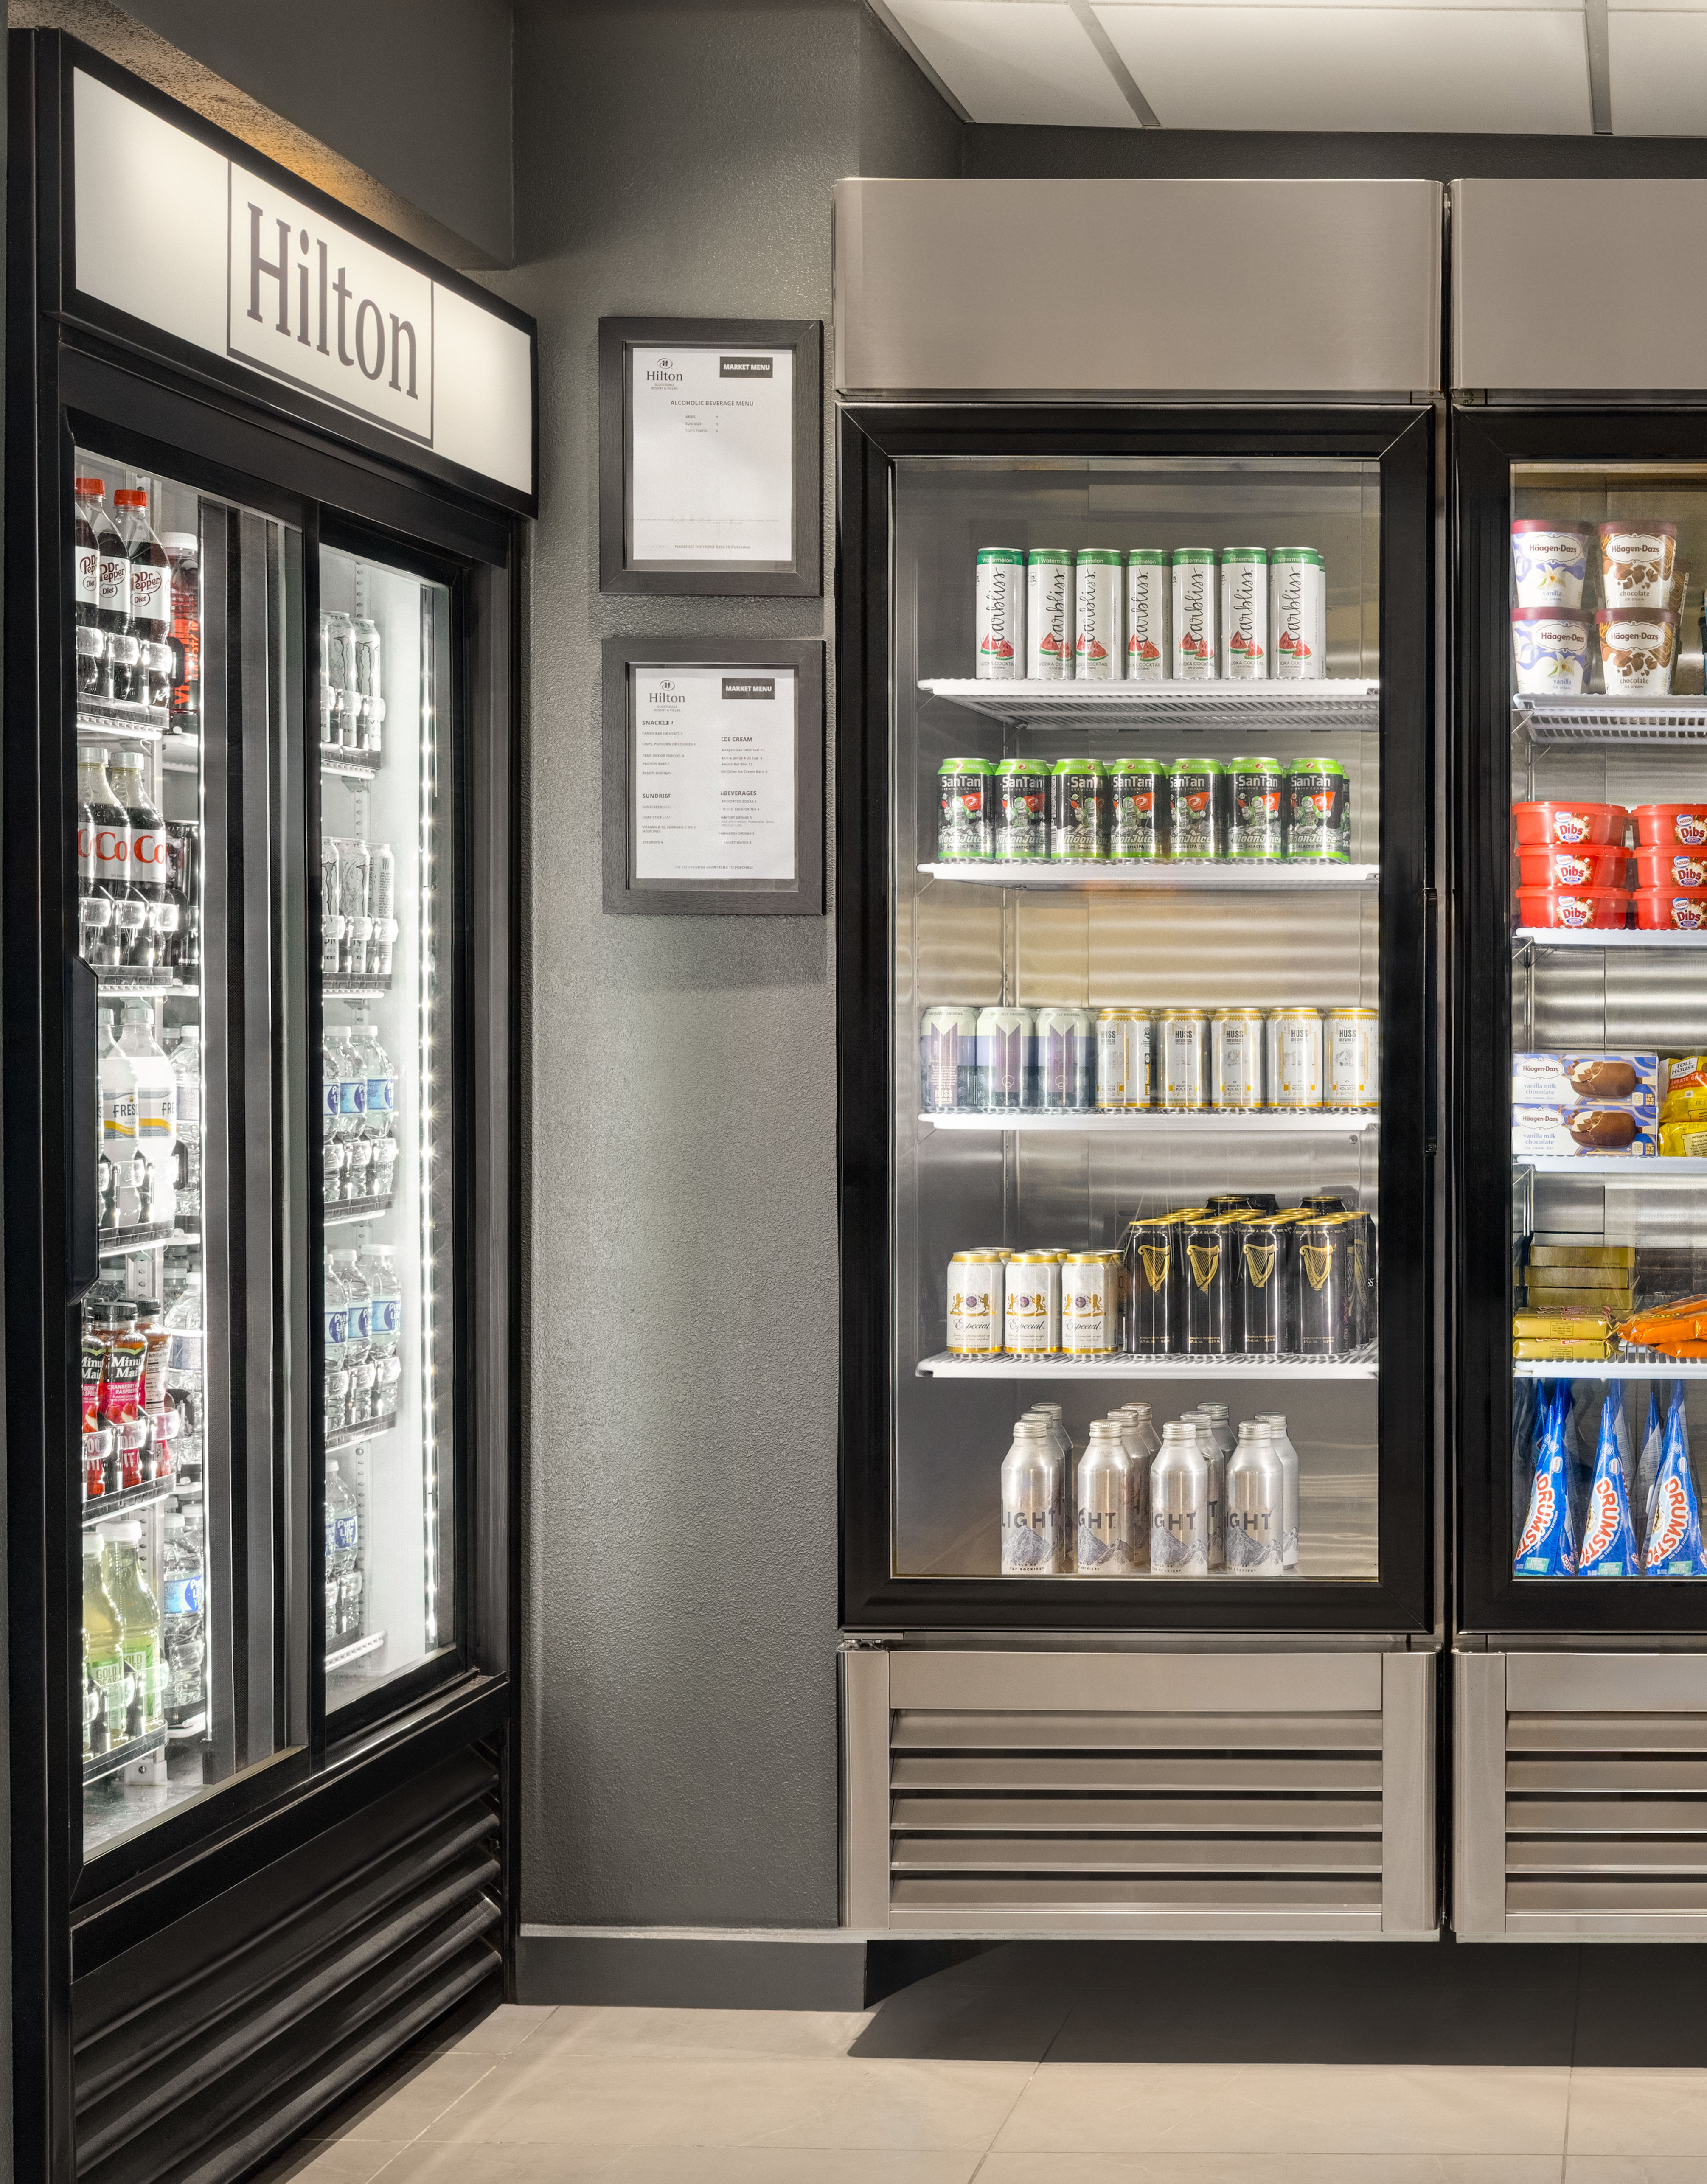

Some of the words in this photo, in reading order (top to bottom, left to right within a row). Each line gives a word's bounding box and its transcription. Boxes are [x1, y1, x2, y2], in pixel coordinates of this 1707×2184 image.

[247, 202, 418, 400] Hilton
[646, 371, 683, 381] Hilton
[108, 562, 119, 572] Dr
[100, 564, 124, 583] Pepper
[140, 572, 153, 581] Dr
[131, 573, 160, 591] Pepper
[649, 693, 685, 703] Hilton
[942, 776, 980, 787] SanTan
[1002, 777, 1042, 788] SanTan
[1113, 776, 1152, 788] SanTan
[1170, 776, 1204, 788] SanTan
[1239, 776, 1277, 787] SanTan
[1291, 776, 1330, 787] SanTan
[1559, 823, 1583, 835] Dibs
[1680, 826, 1705, 838] Dibs
[1560, 866, 1584, 878] Dibs
[1678, 868, 1701, 880] Dibs
[1563, 907, 1587, 920] Dibs
[1677, 910, 1701, 922] Dibs
[1175, 1030, 1192, 1038] HUSS
[1671, 1064, 1695, 1074] HOUSE
[1676, 1060, 1692, 1068] TOLL
[337, 1519, 354, 1528] Pure
[340, 1527, 354, 1538] Life
[1541, 1528, 1553, 1542] FAVORITE
[1611, 1531, 1620, 1546] FAVORITE
[1681, 1530, 1690, 1545] FAVORITE
[96, 1666, 117, 1679] GOLD
